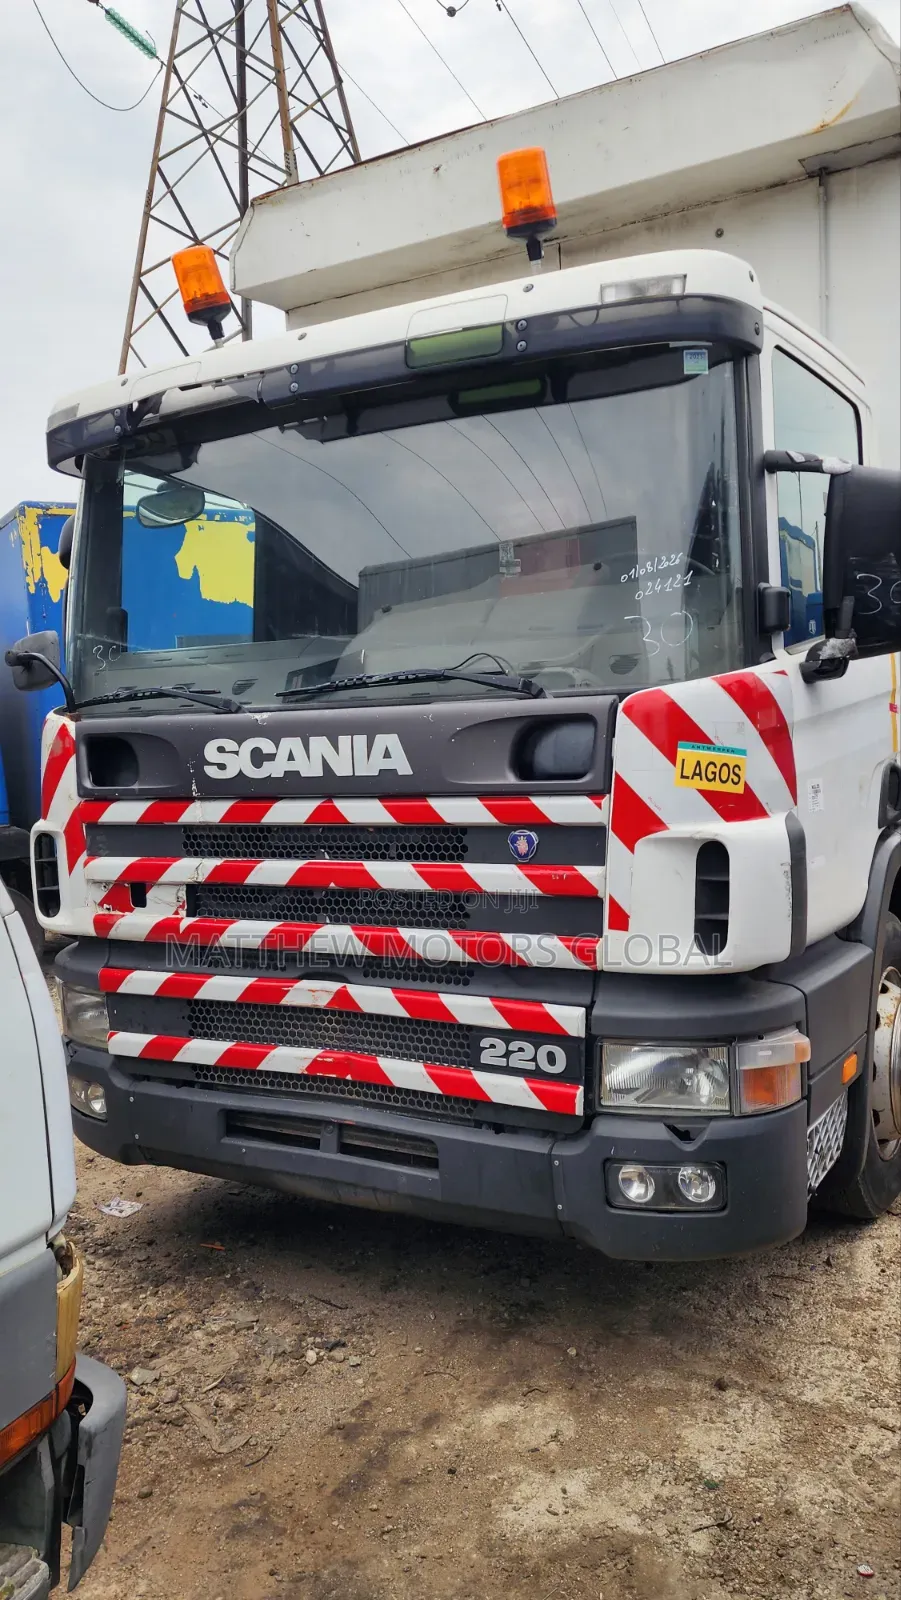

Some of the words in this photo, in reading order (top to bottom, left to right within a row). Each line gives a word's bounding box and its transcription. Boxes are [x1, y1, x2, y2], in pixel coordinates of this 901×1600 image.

[635, 570, 693, 600] 024121
[624, 610, 694, 657] 30
[203, 733, 413, 779] SCANIA
[680, 758, 741, 785] LAGOS
[479, 1037, 567, 1074] 220
